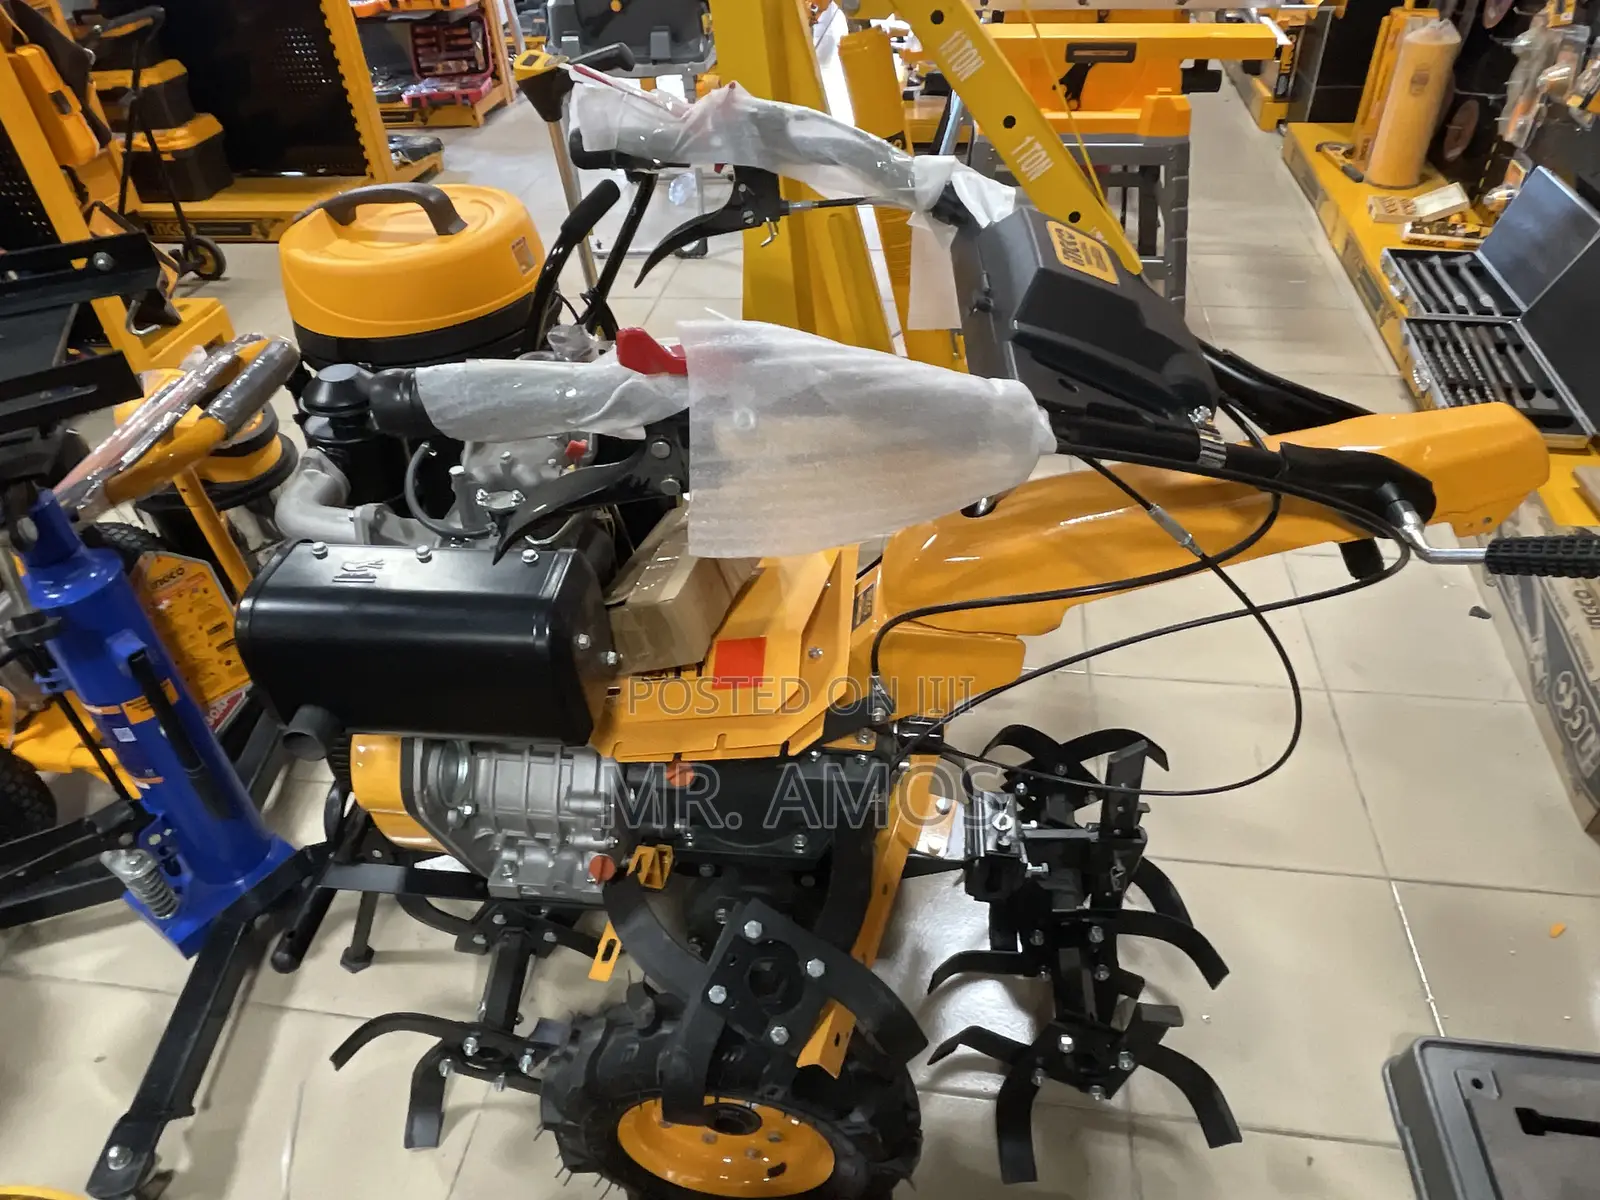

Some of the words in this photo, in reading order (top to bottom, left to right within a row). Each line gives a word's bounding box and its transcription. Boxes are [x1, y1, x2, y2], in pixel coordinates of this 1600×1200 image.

[947, 39, 985, 82] TON
[1011, 135, 1036, 156] 1
[1016, 141, 1055, 182] TON
